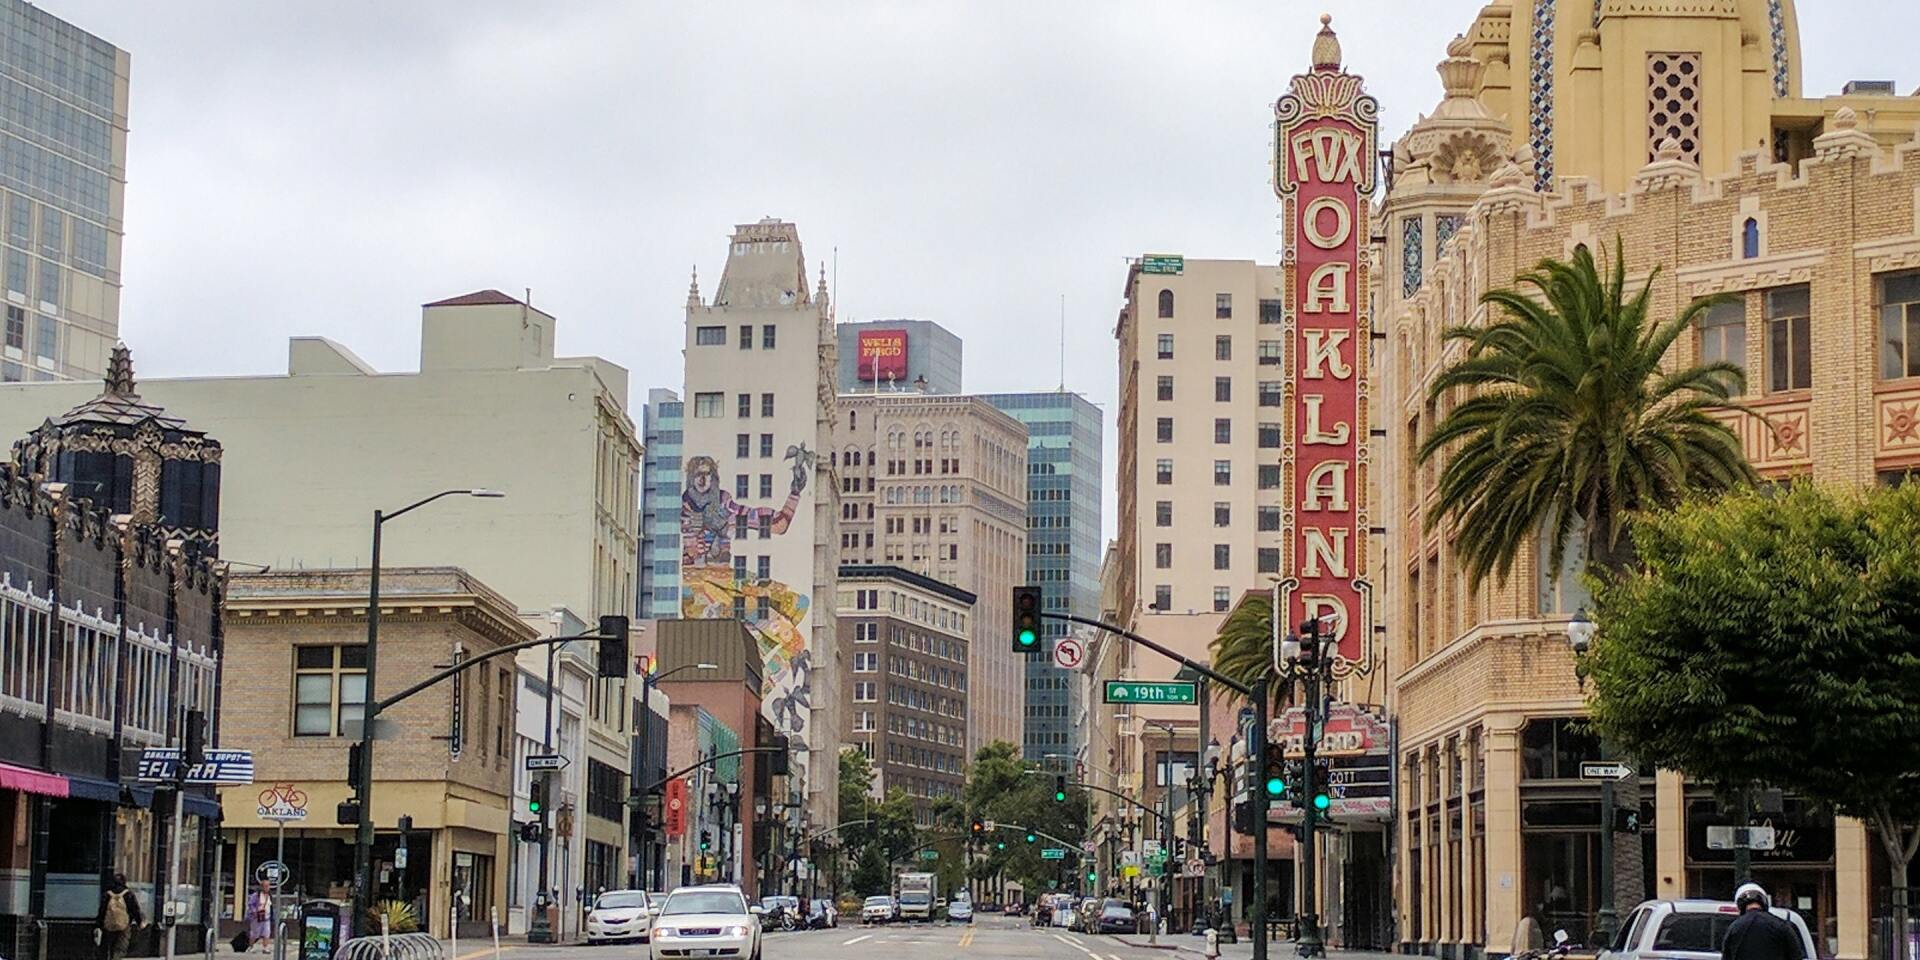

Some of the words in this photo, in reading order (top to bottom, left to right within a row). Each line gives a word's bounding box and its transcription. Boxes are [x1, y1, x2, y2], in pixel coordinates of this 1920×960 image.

[1290, 126, 1364, 184] FOX
[862, 337, 902, 347] WELLS
[863, 347, 901, 357] FARGO
[1302, 195, 1352, 645] OAKLAND
[1134, 686, 1164, 700] 19th
[149, 761, 217, 778] FLRA
[1586, 767, 1601, 775] ONE
[1603, 767, 1618, 775] WAY
[1328, 771, 1355, 784] COTT
[257, 807, 308, 817] OAKLAND
